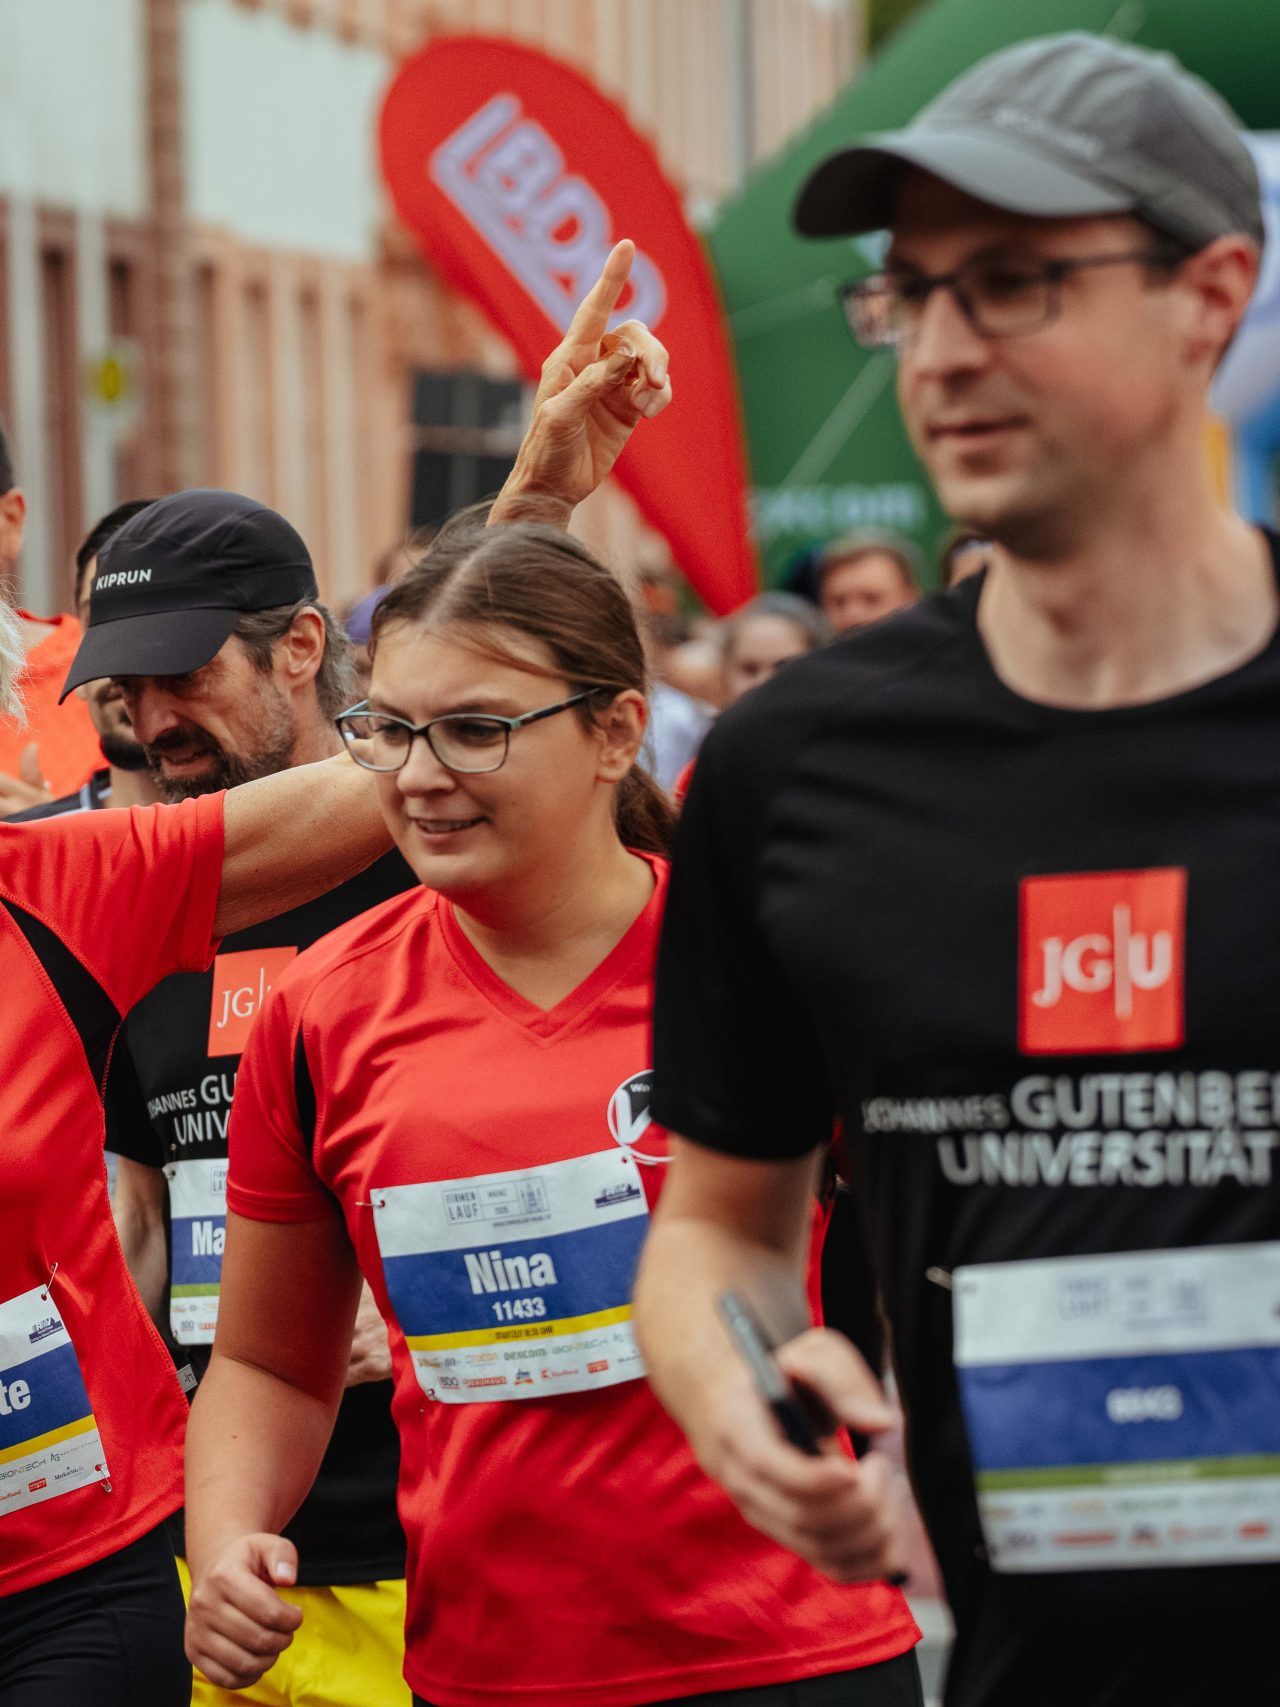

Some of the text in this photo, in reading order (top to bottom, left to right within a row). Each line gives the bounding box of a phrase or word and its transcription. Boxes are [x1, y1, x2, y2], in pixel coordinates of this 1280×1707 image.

[95, 568, 152, 591] KIPRUN
[1010, 1069, 1280, 1130] GUTENBE
[937, 1124, 1279, 1188] UNIVERSITÄT
[448, 1203, 478, 1220] LAUF
[464, 1250, 558, 1295] Nina
[492, 1297, 547, 1321] 11433
